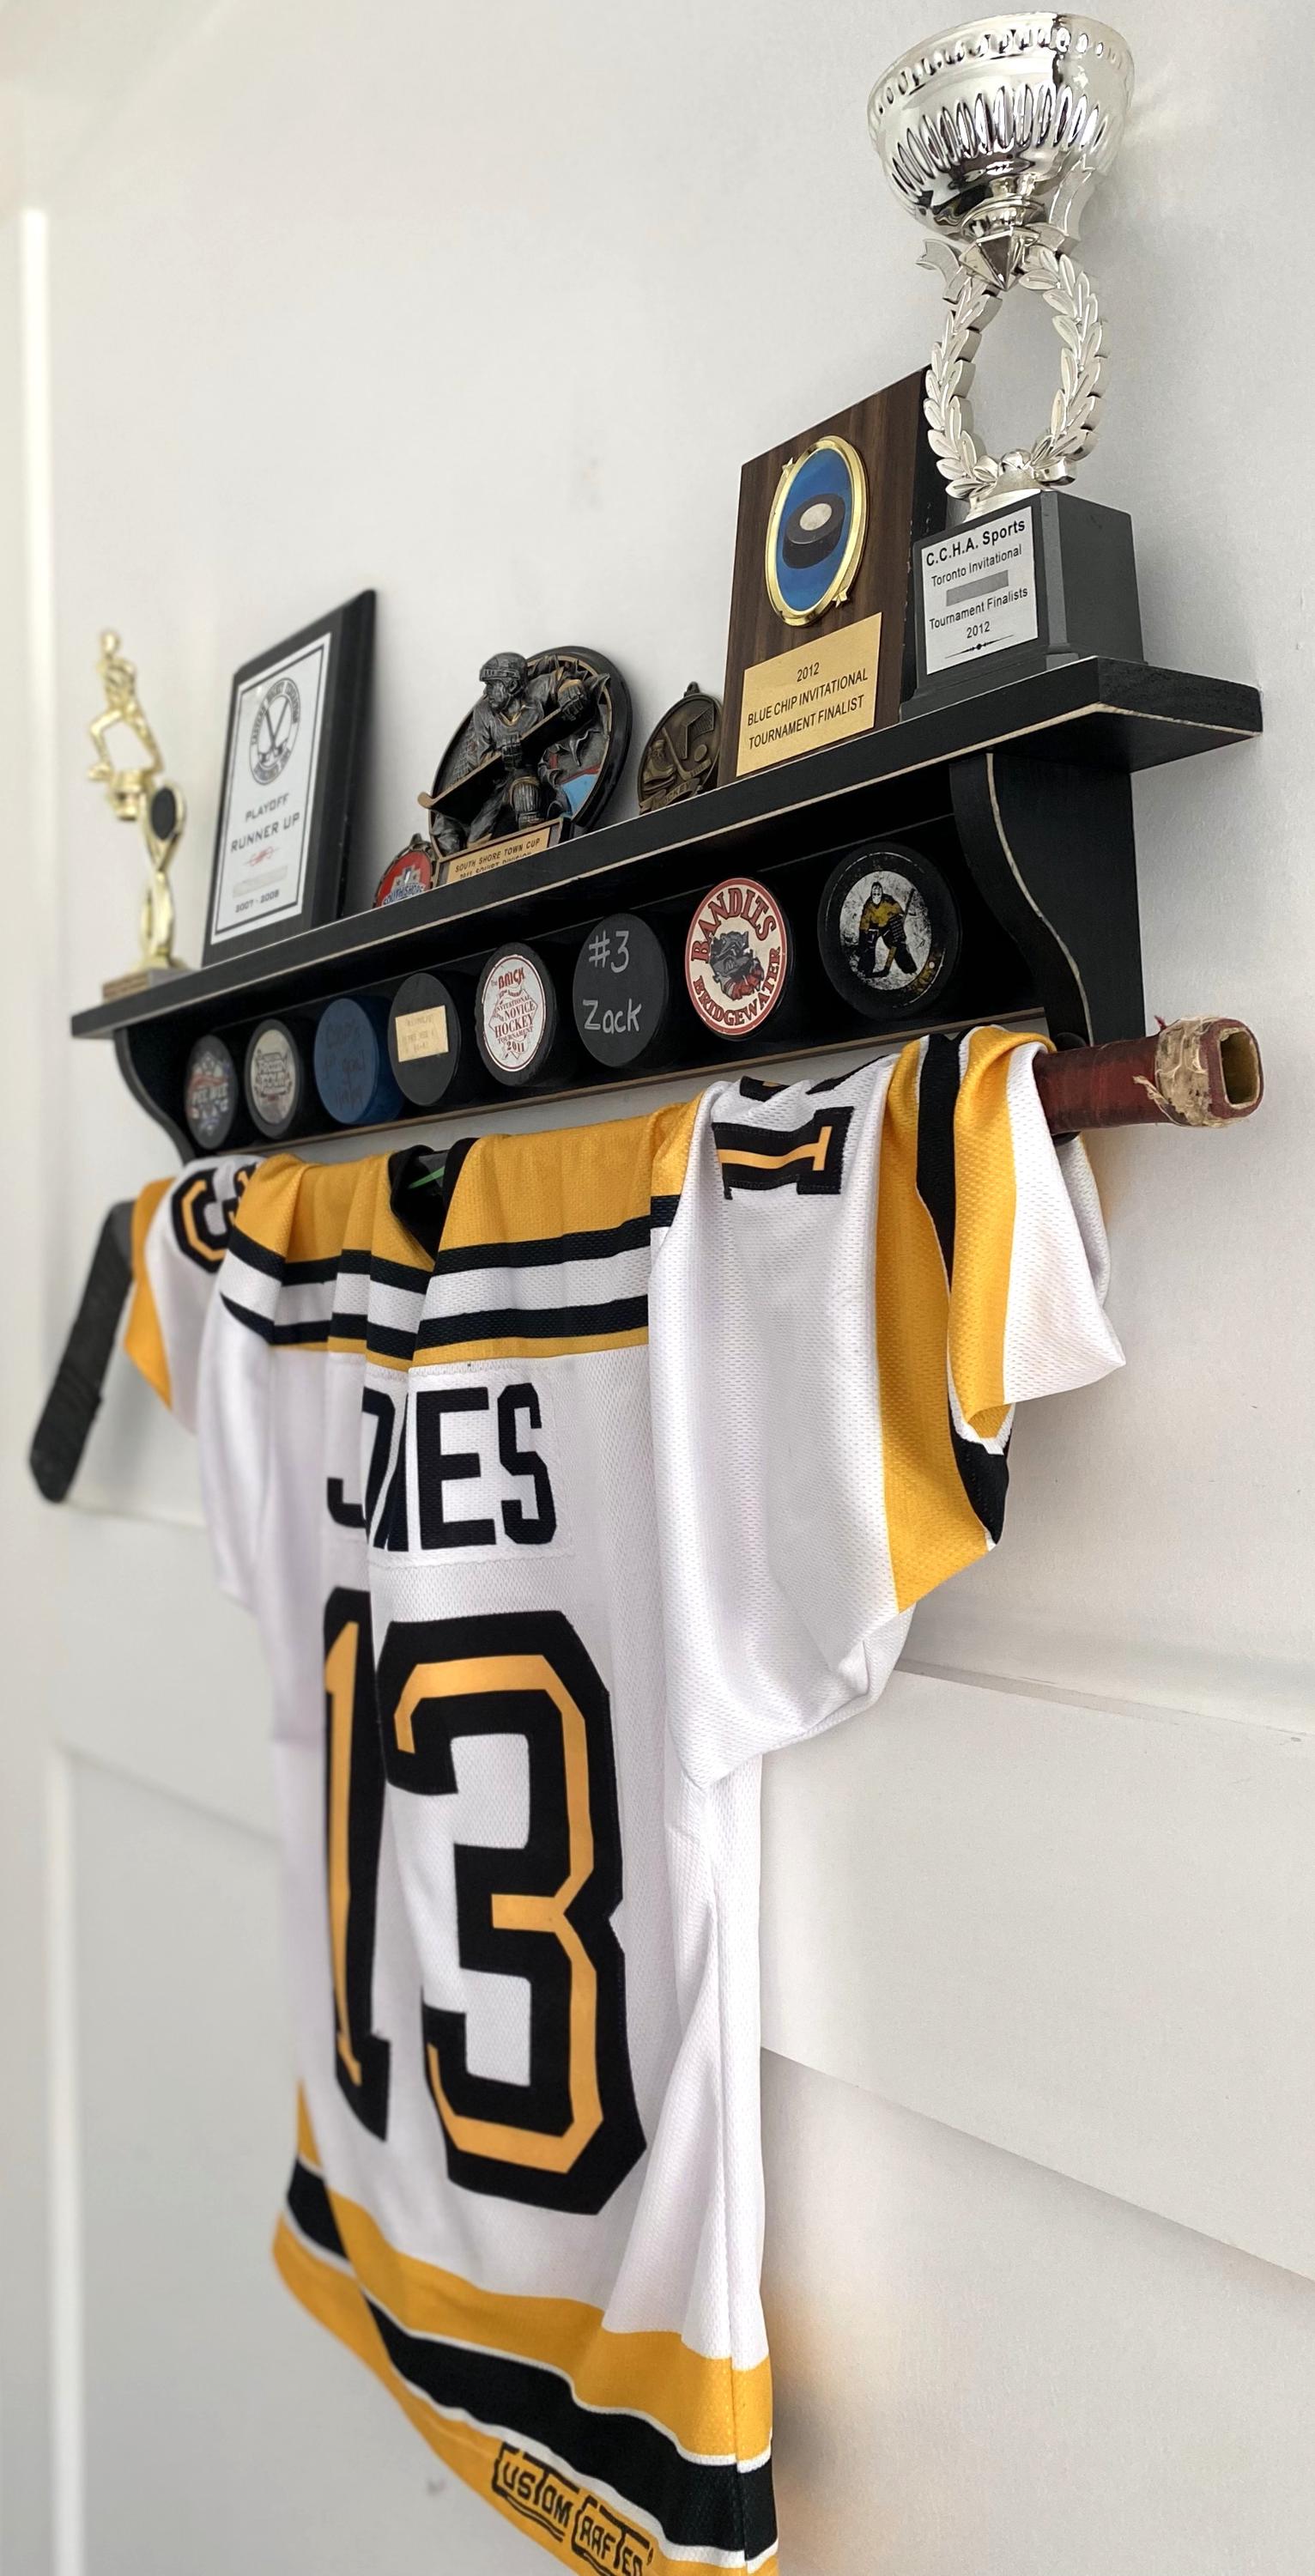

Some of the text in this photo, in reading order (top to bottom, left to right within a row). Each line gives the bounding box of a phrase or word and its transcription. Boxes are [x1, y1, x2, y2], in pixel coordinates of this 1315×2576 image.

[926, 519, 1025, 566] C.C.H.A. Sports
[931, 544, 1021, 587] Toronto Invitational
[930, 587, 1027, 629] Tournament Finalists
[967, 621, 991, 639] 2012
[797, 662, 820, 682] 2012
[748, 668, 868, 726] BLUE CHIP INVITATIONAL
[749, 695, 864, 749] TOURNAMENT FINALIST
[245, 793, 289, 822] PLAYOFF
[231, 812, 300, 853] RUNNER UP
[455, 860, 476, 872] SOUTH
[479, 851, 501, 865] SHORE
[505, 844, 523, 856] TOWN
[526, 838, 540, 848] CUP
[235, 899, 253, 913] 2007
[691, 887, 776, 964] BANDITS
[589, 930, 629, 973] #3
[499, 967, 524, 989] BRICK
[693, 946, 781, 1025] BRIDGEWATER
[494, 995, 530, 1013] INVITATIONAL
[505, 1000, 536, 1021] NOVICE
[583, 998, 642, 1034] Zack
[494, 1013, 533, 1038] HOCKEY
[498, 1025, 533, 1044] TOURNAMENT
[506, 1041, 524, 1053] 2011
[324, 1586, 645, 2215] 13
[492, 2441, 581, 2530] CUSTOM
